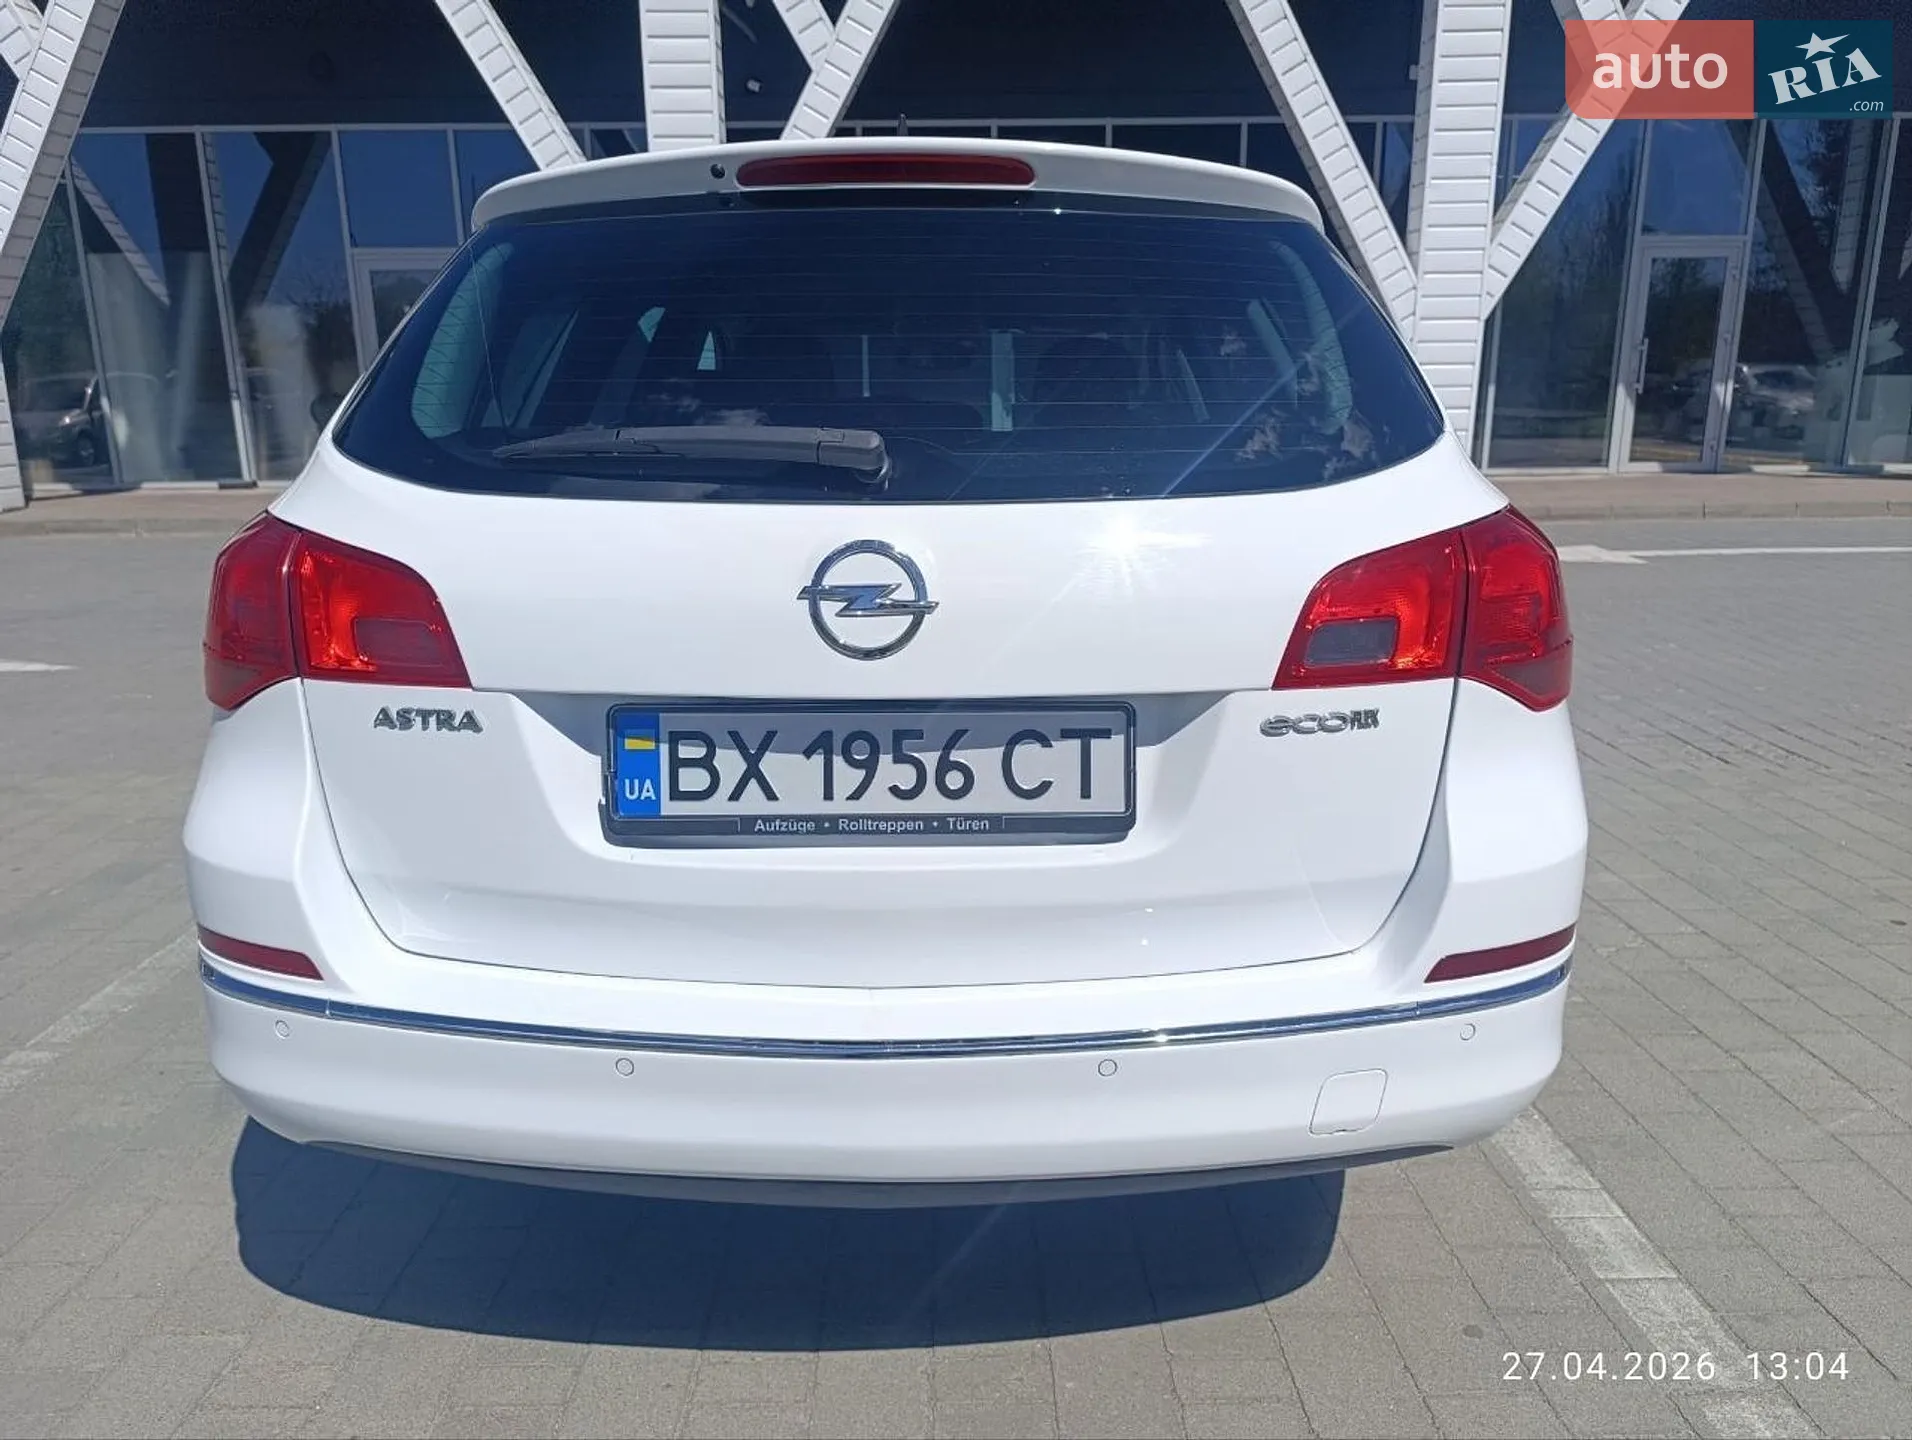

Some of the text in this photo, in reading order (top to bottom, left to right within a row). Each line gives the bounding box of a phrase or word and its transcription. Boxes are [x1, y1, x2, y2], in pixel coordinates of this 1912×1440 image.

[373, 706, 484, 733] ASTRA
[668, 727, 1113, 802] BX 1956 CT
[624, 778, 656, 801] UA
[754, 816, 990, 834] Aufzüge Rolltreppen Türen
